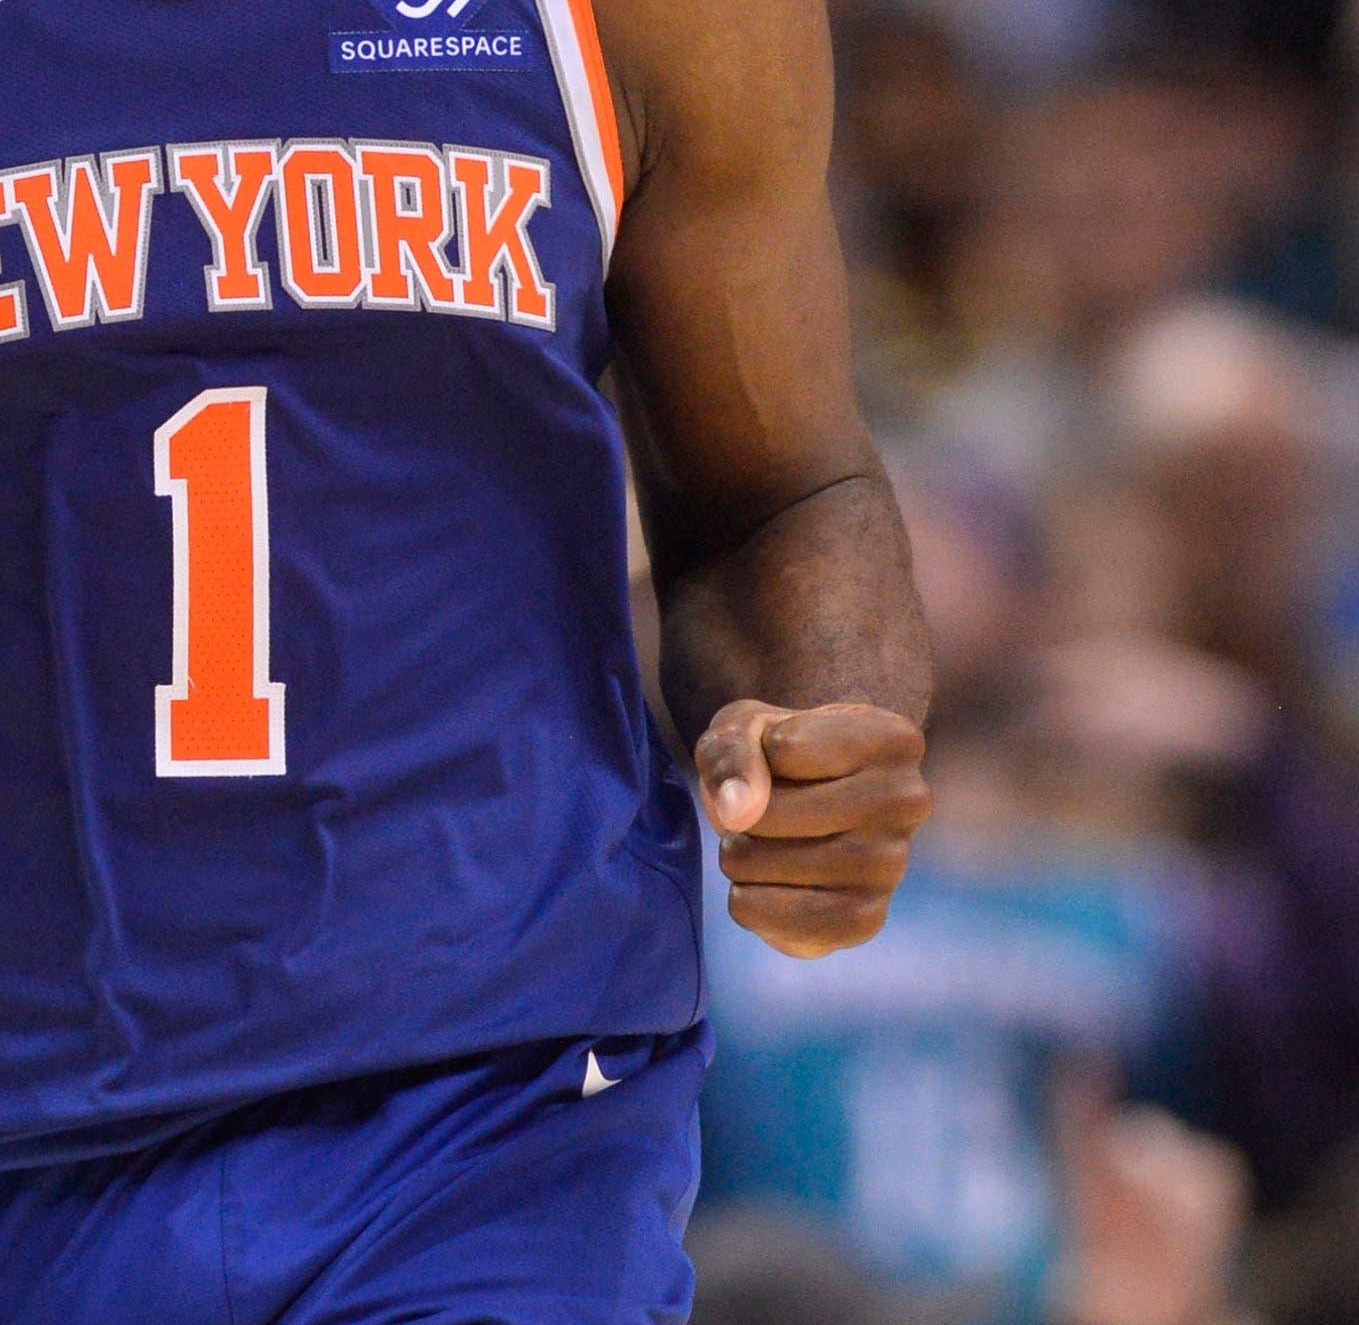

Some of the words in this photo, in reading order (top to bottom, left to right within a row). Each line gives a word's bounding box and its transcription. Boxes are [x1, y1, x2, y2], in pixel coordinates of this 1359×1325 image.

[341, 36, 522, 61] SQUARESPACE
[168, 137, 556, 331] YORK
[154, 386, 286, 777] 1
